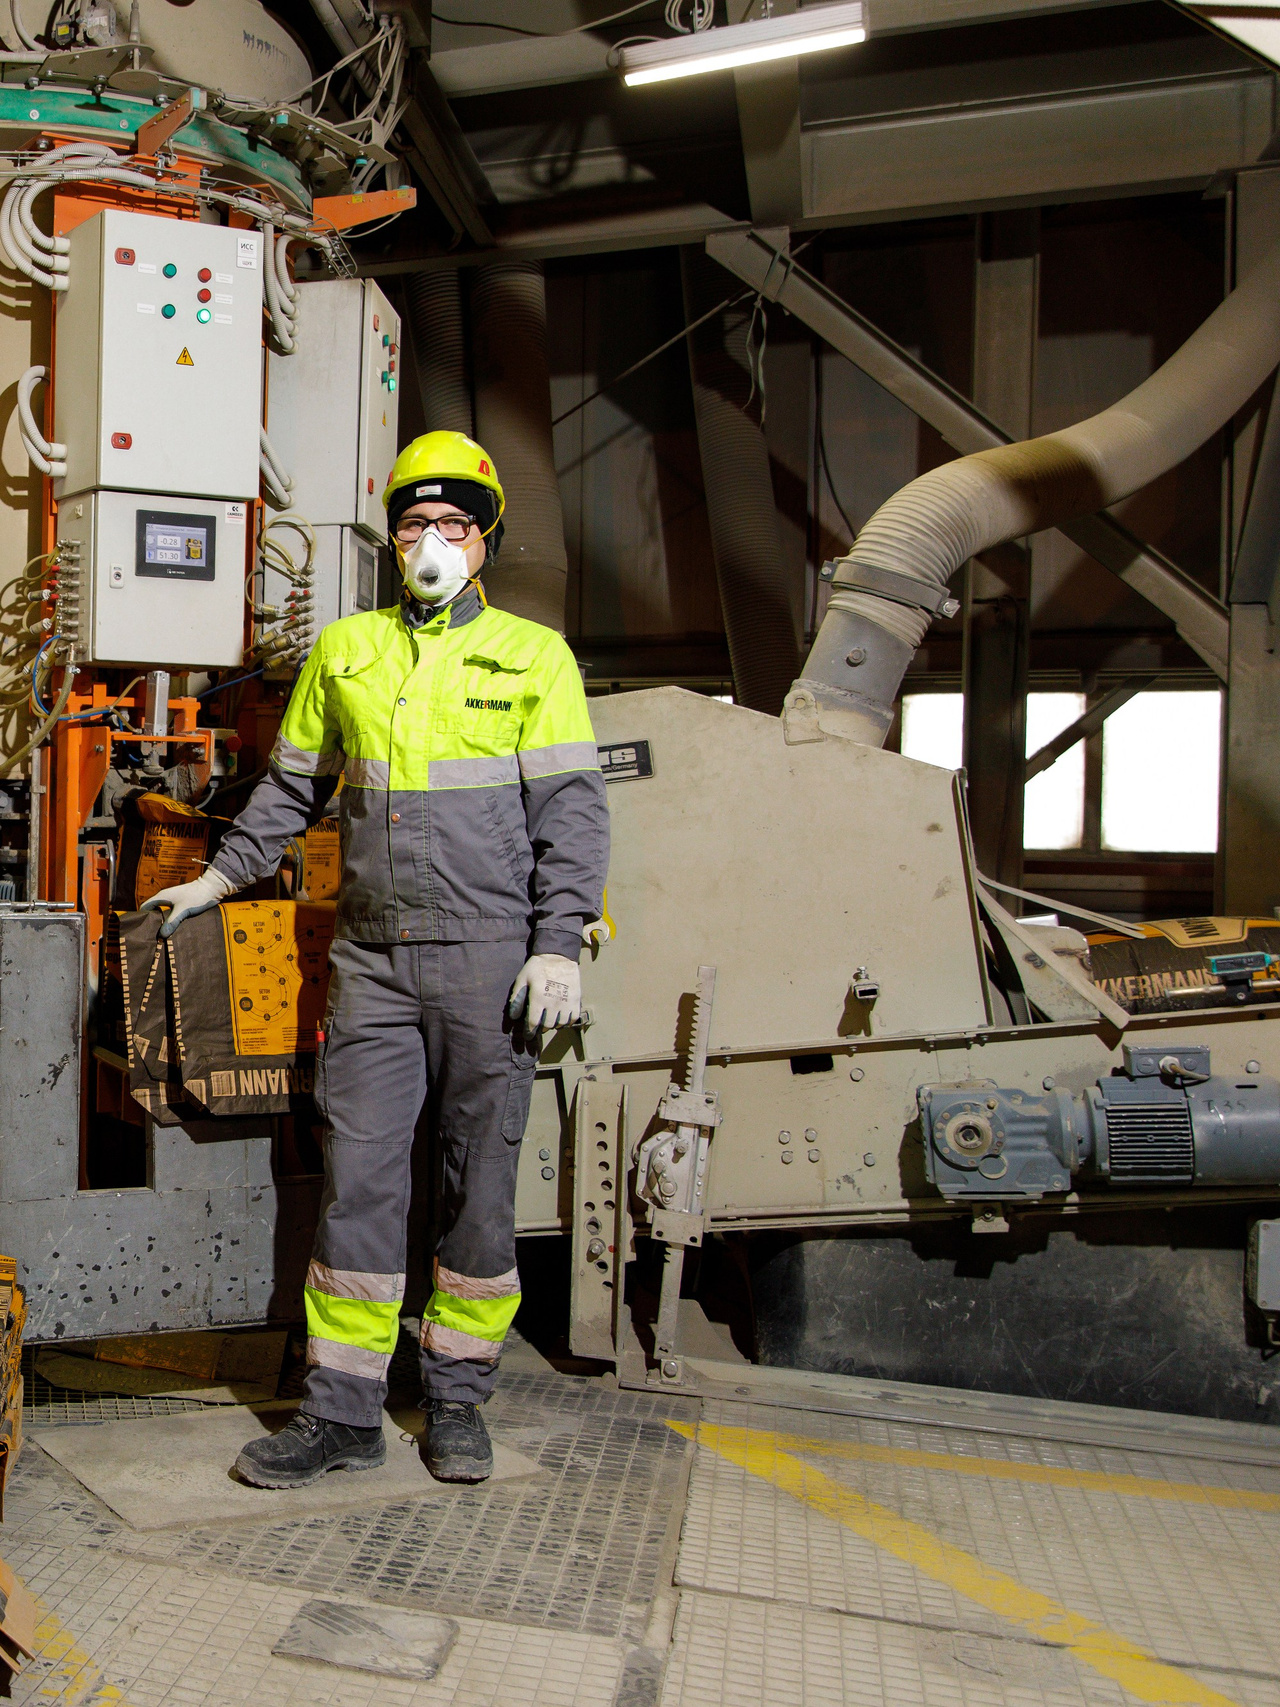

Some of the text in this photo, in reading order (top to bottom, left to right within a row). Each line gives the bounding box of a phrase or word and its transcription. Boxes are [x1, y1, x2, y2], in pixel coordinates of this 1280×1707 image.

[160, 538, 178, 546] -0.28
[159, 552, 179, 560] 51.30
[464, 697, 513, 712] AKKERMANN
[1095, 968, 1219, 1002] KKERMANN
